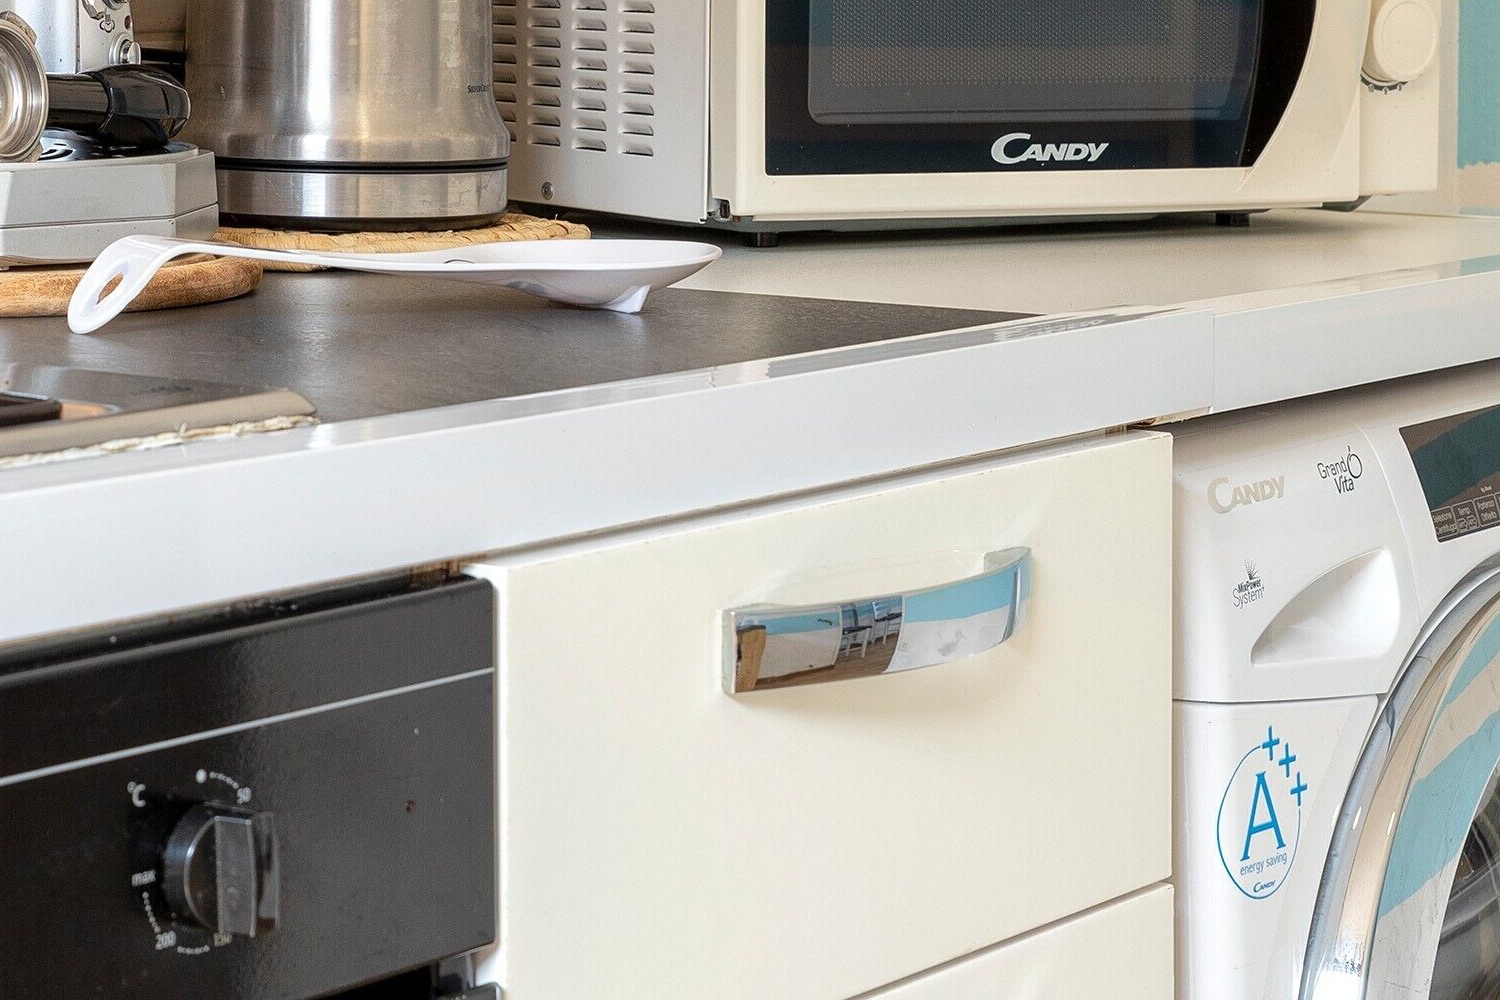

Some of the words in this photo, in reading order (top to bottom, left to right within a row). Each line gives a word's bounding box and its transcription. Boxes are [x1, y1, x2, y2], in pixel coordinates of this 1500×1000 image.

[991, 132, 1109, 165] CANDY
[1206, 475, 1285, 514] CANDY
[1334, 475, 1355, 494] Vita
[1240, 860, 1265, 876] energy
[1266, 852, 1288, 867] saving
[1253, 880, 1276, 893] CANDY
